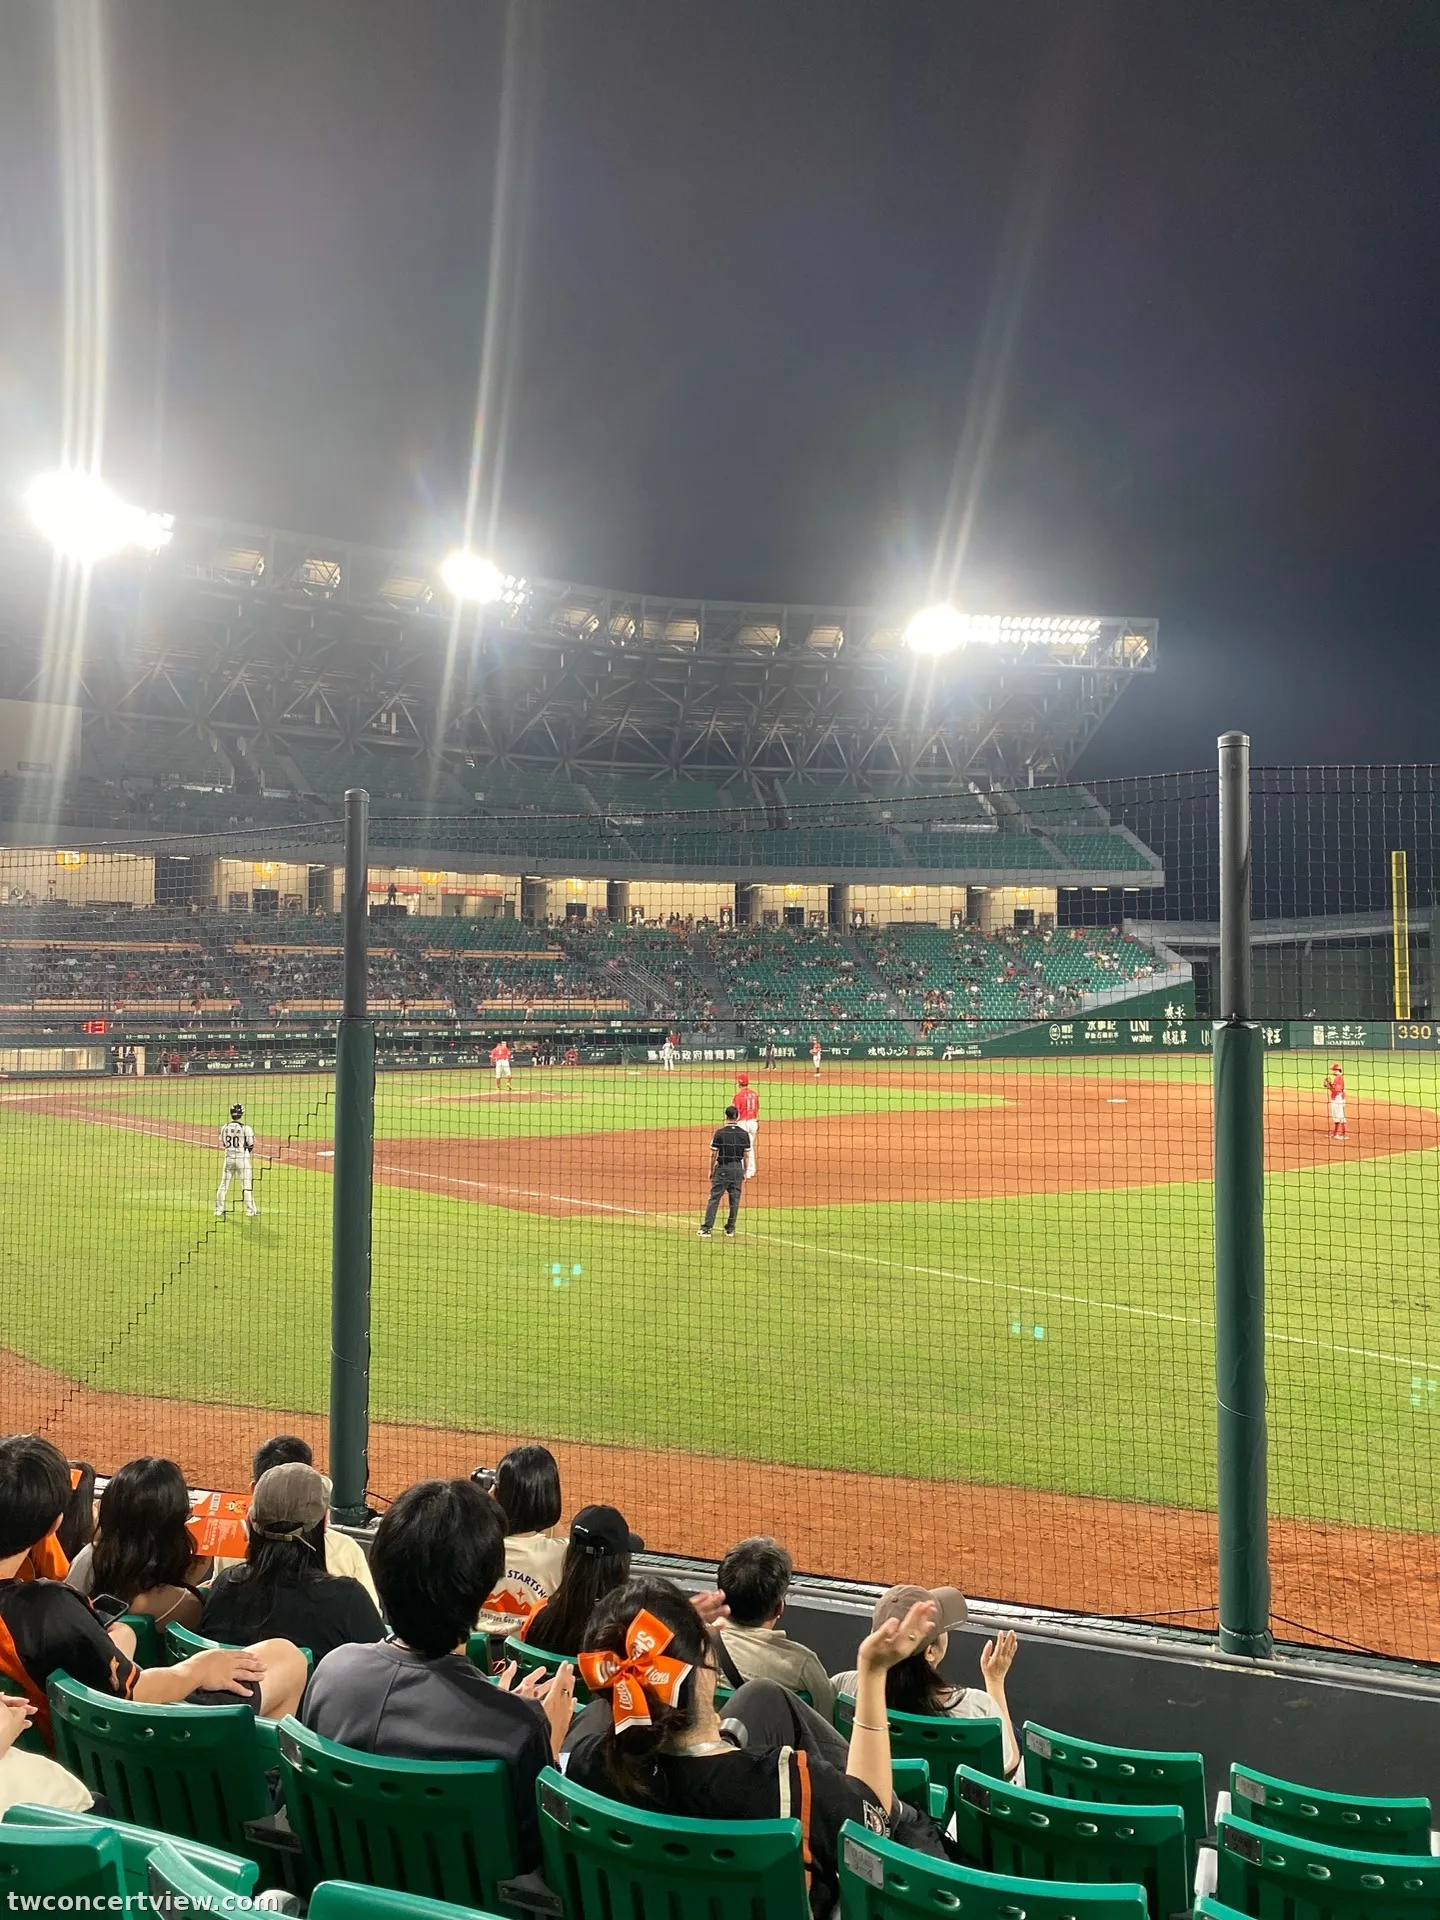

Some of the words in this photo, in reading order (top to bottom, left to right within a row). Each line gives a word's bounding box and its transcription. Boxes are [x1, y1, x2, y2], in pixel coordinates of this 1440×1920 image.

[1129, 1020, 1150, 1032] UNI
[1397, 1025, 1432, 1040] 330
[1130, 1033, 1154, 1043] water
[507, 1569, 541, 1592] STARTS
